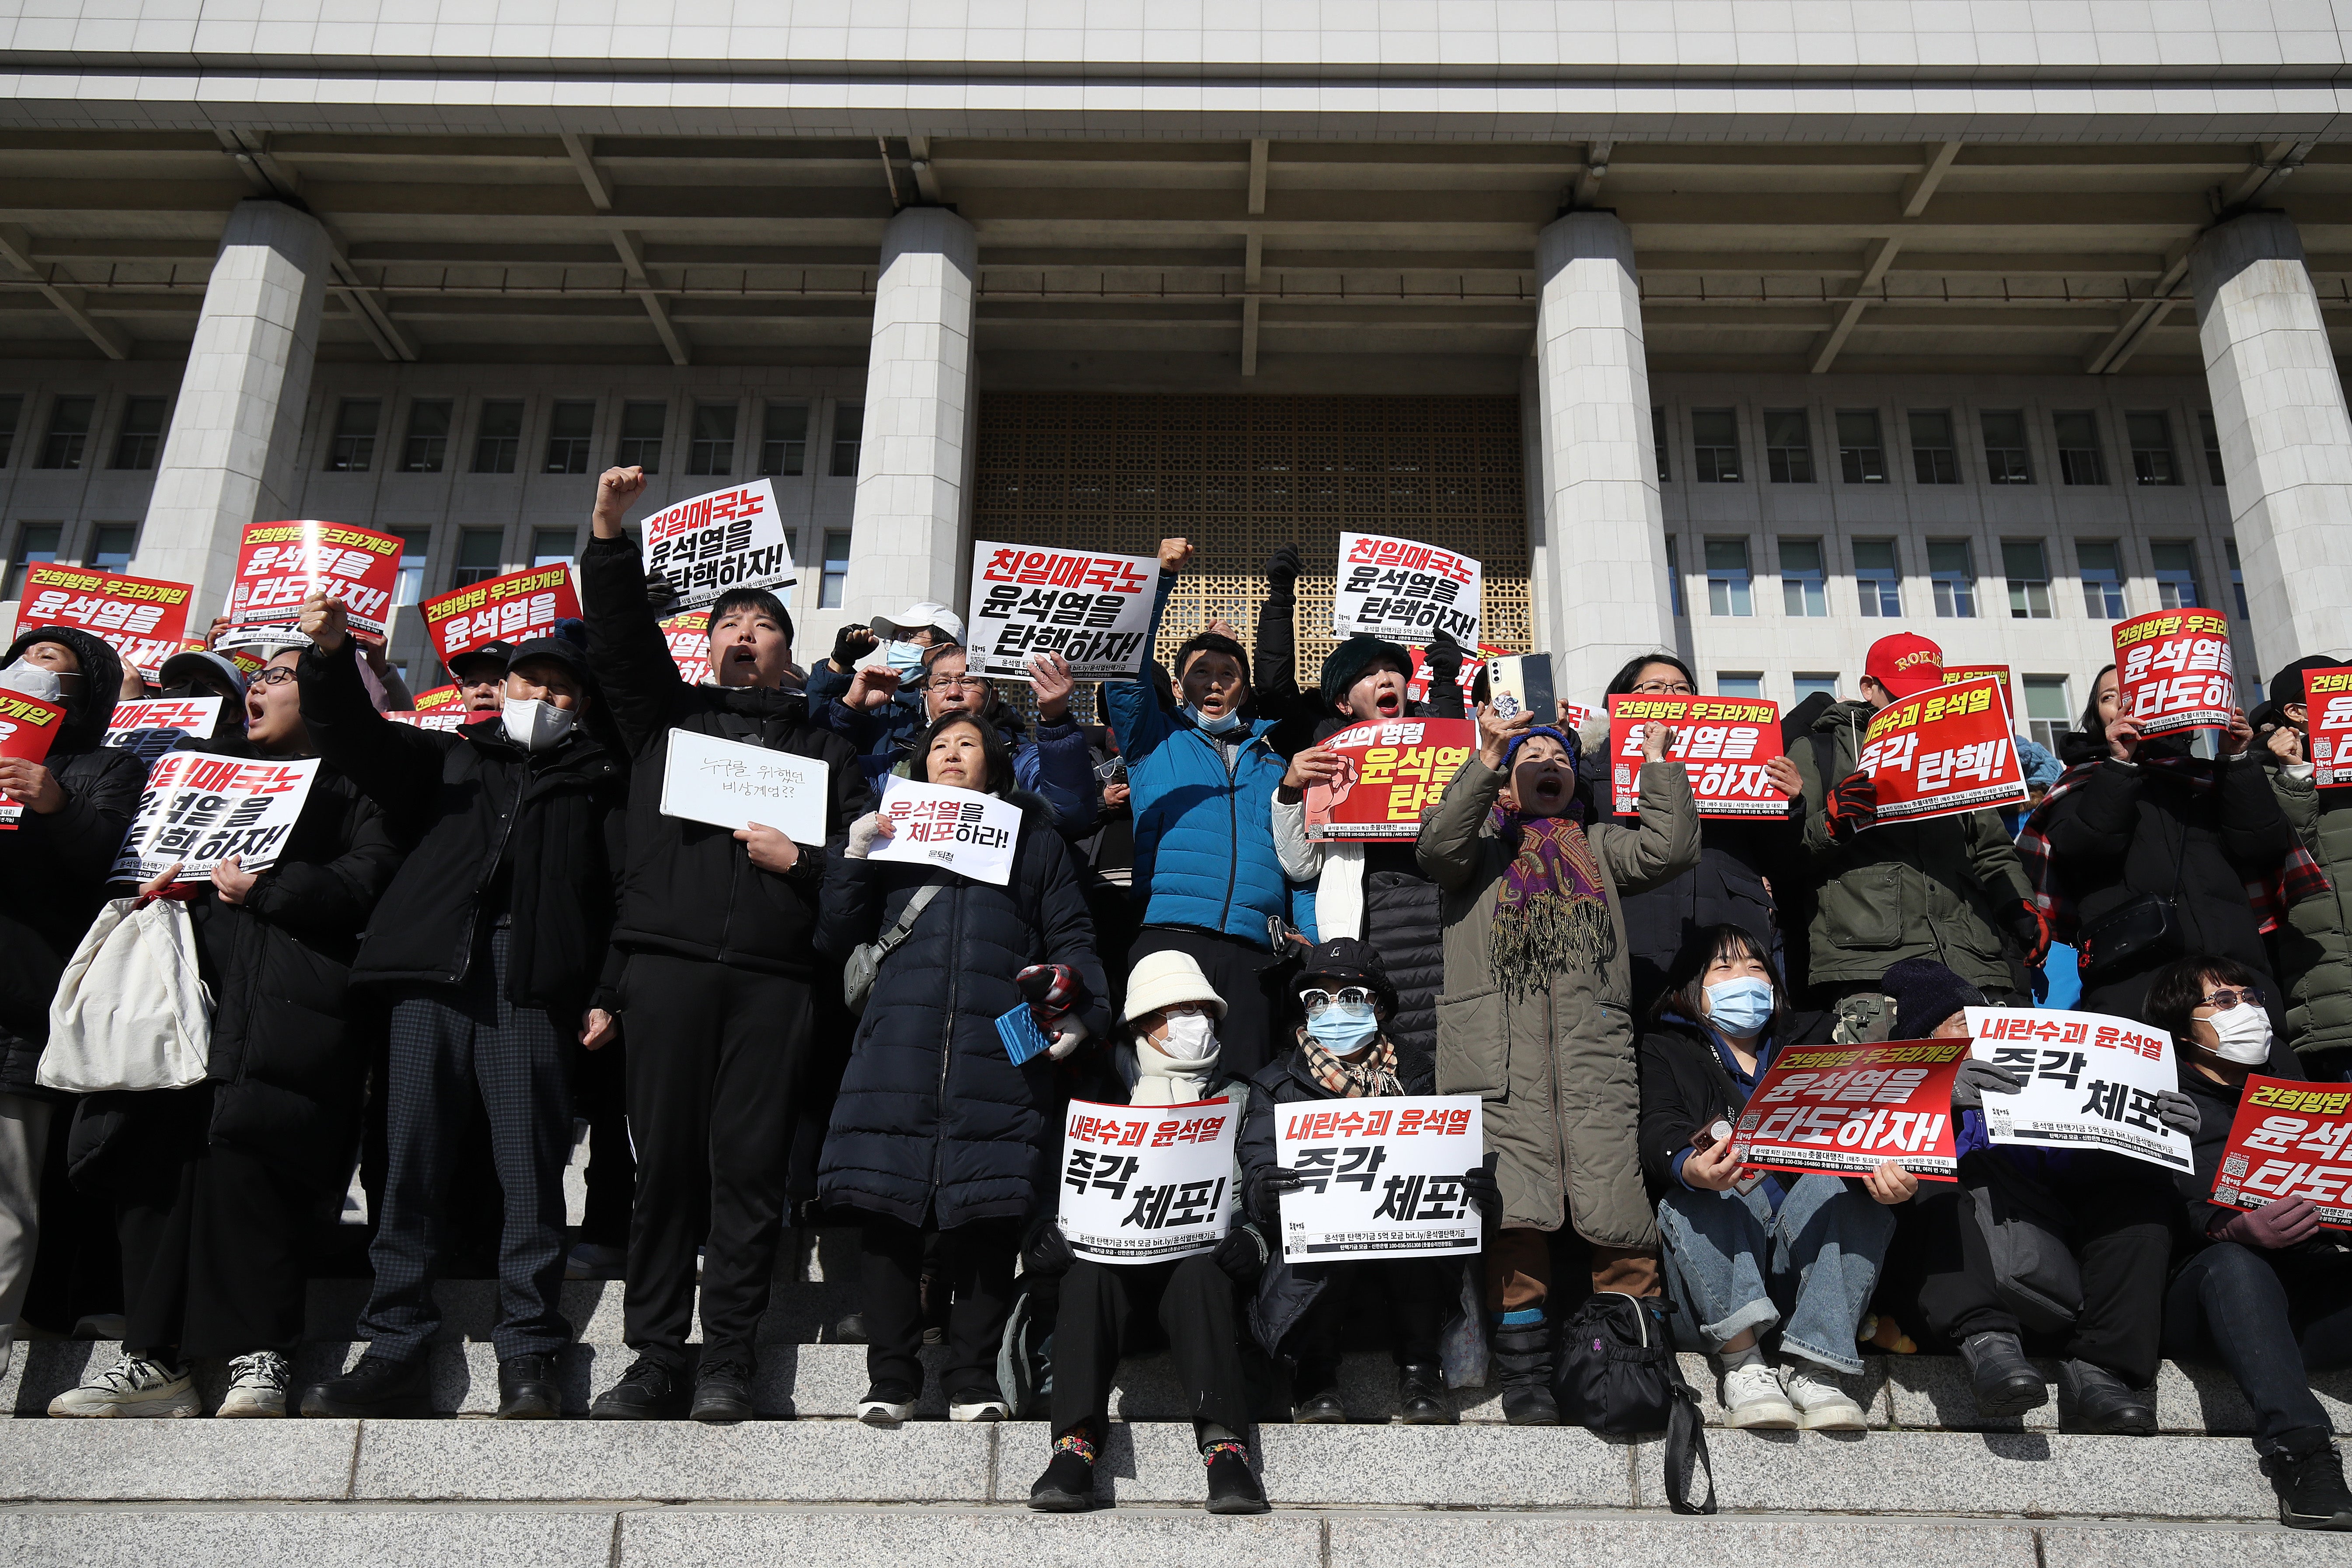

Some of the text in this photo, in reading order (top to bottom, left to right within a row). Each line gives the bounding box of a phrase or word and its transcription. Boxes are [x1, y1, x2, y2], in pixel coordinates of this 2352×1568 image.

[648, 489, 764, 546] 친일매국노
[316, 528, 398, 556] 우크라개입
[649, 519, 753, 574] 윤석열을
[243, 545, 375, 580] 윤석열을
[666, 543, 784, 597] 탄핵하자!
[983, 548, 1149, 594] 친일매국노
[1347, 538, 1474, 585] 친일매국노
[30, 569, 188, 605] 건희방탄 우크라개입
[427, 569, 565, 623] 건희방탄 우크라개입
[692, 592, 712, 603] 탄핵기금
[1344, 566, 1460, 605] 윤석열을
[27, 590, 165, 634] 윤석열을
[444, 592, 557, 654] 윤석열을
[978, 584, 1126, 629] 윤석열을
[1356, 597, 1477, 640] 탄핵하자!
[992, 623, 1145, 663] 탄핵하자!
[2116, 615, 2183, 649] 건희방탄
[1002, 659, 1020, 667] 윤석열
[416, 689, 454, 710] 건희방탄
[1614, 701, 1688, 719] 건희방탄
[1689, 702, 1774, 723] 우크라개입
[1864, 687, 1992, 744] 내란수괴 윤석열
[2180, 711, 2212, 720] 촛불대행진
[1380, 723, 1426, 745] 명령
[700, 757, 805, 784] 누구를 위했던
[1857, 732, 1919, 779] 즉각
[1917, 738, 2008, 792] 탄핵!
[723, 781, 795, 798] 비상계엄??
[1912, 797, 1939, 808] 촛불대행진
[888, 800, 984, 823] 윤석열을
[906, 822, 1009, 849] 체포하라!
[928, 850, 954, 862] 윤퇴청
[1776, 1045, 1966, 1069] 건희방탄 우크라개입
[1979, 1019, 2164, 1062] 내란수괴 윤석열
[1759, 1068, 1929, 1104] 윤석열을
[1992, 1048, 2087, 1090] 즉각
[1992, 1106, 2010, 1116] 촛불행동
[2247, 1085, 2352, 1114] 건희방탄
[1068, 1114, 1227, 1147] 내란수괴 윤석열
[1285, 1109, 1472, 1140] 내란수괴 윤석열
[1753, 1106, 1946, 1152] 타도하자!
[2032, 1121, 2174, 1155] 윤석열 탄핵기금 5억 모금 bit.ly/윤석열탄핵기금
[1808, 1151, 1844, 1162] 촛불대행진
[2101, 1137, 2132, 1150] 100-036-551308
[1065, 1149, 1140, 1200] 즉각
[1294, 1145, 1387, 1194] 즉각
[1785, 1159, 1821, 1167] 100-036-164860
[1120, 1176, 1227, 1230] 체포!
[1372, 1175, 1472, 1221] 체포!
[2245, 1195, 2262, 1204] 윤석열
[1079, 1231, 1216, 1247] 윤석열 탄핵기금 5억 모금 bit.ly/윤석열탄핵기금
[1135, 1248, 1168, 1257] 100-036-551308
[1324, 1229, 1466, 1242] 윤석열 탄핵기금 5억 모금 bit.ly/윤석열탄핵기금
